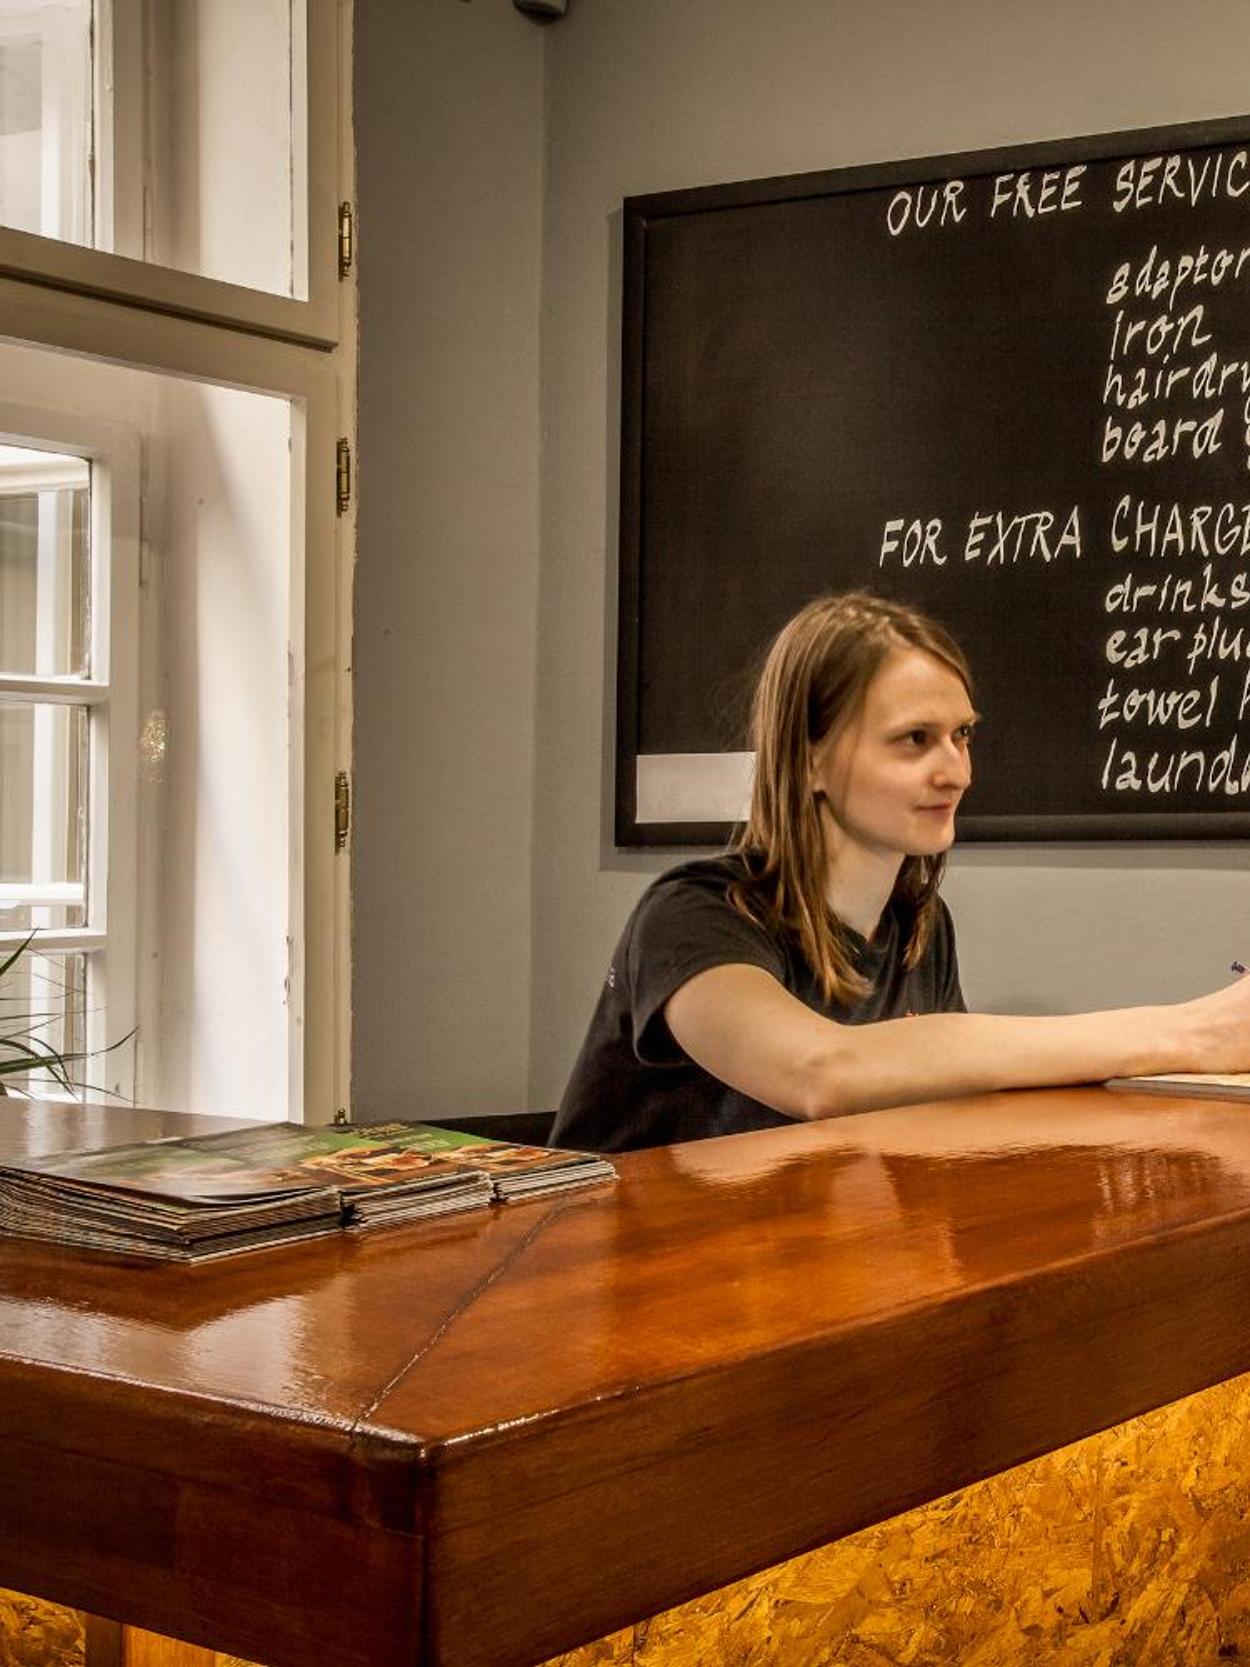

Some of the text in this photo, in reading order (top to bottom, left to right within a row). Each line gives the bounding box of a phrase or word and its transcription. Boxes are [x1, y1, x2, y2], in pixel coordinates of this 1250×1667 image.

[887, 180, 967, 236] OUR
[991, 165, 1087, 219] FREE
[1101, 407, 1225, 463] board
[879, 511, 948, 568] FOR
[964, 504, 1082, 566] EXTRA
[1105, 626, 1182, 669] ear
[1098, 674, 1220, 731] towel
